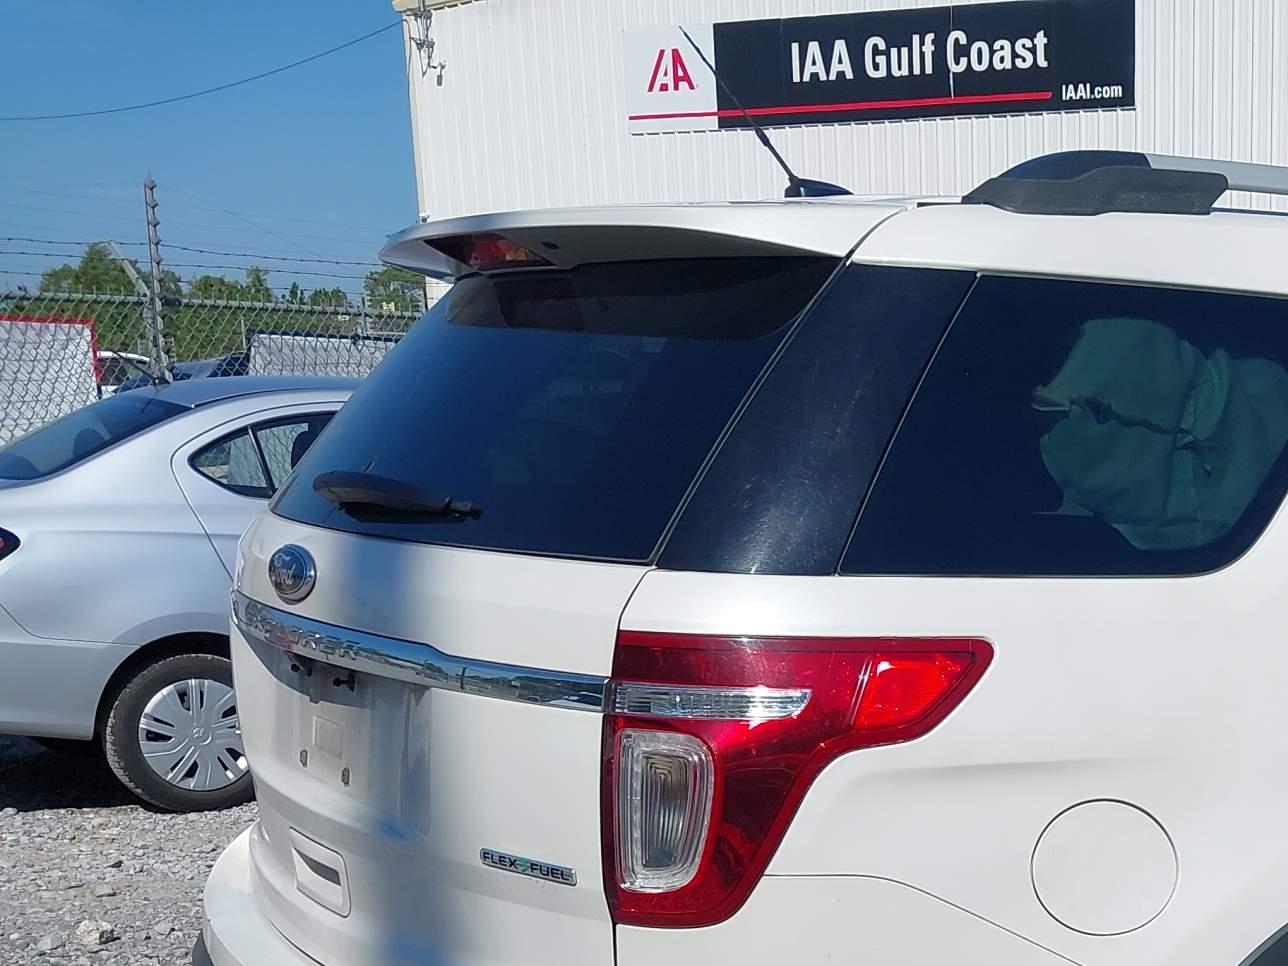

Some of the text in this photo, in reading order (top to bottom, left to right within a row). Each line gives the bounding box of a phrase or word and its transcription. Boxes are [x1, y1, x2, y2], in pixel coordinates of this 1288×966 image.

[791, 29, 1049, 83] IAA Gulf Coast
[1062, 83, 1122, 100] IAAI.com
[482, 851, 571, 881] FLEX FUEL
